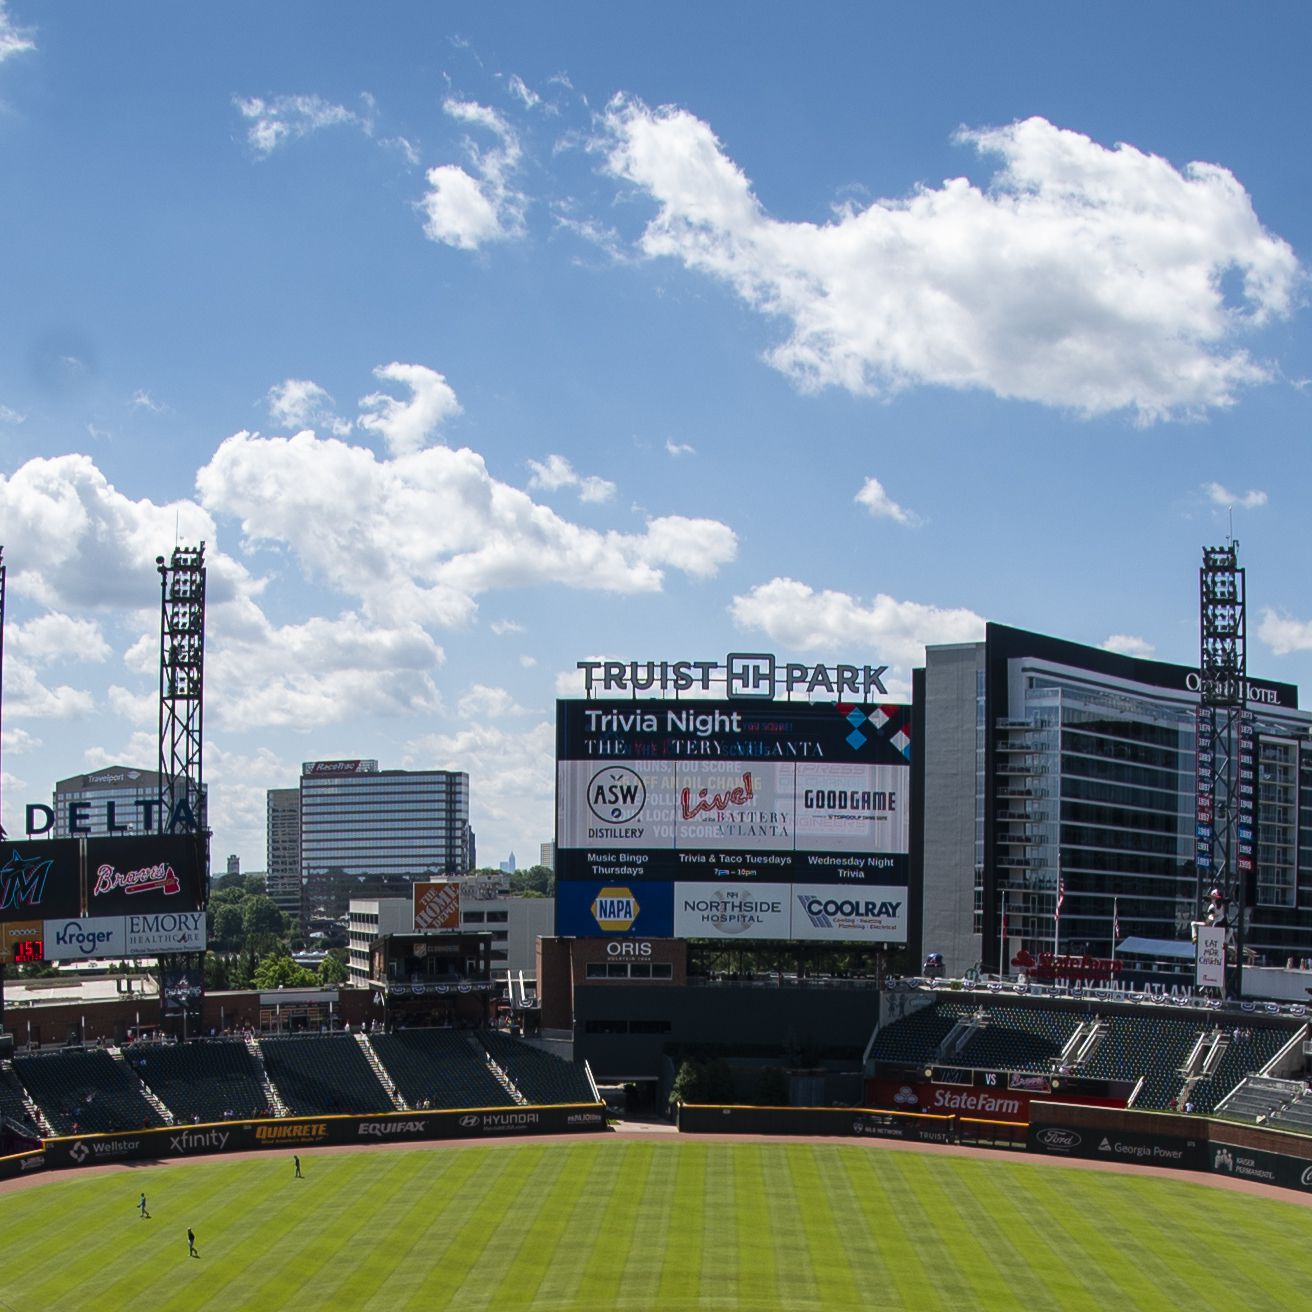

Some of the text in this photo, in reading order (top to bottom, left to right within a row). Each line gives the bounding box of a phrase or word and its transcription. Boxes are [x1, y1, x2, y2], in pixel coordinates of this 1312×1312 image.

[577, 661, 888, 695] TRUIST PARK
[1238, 680, 1281, 704] HOTEL
[585, 710, 657, 732] Trivia
[667, 710, 742, 736] Night
[585, 739, 626, 755] THE
[88, 773, 125, 784] Travelport
[593, 785, 639, 805] ASW
[681, 772, 754, 820] Live!
[26, 799, 199, 835] DELTA
[717, 811, 789, 823] BATTERY
[588, 828, 644, 839] DISTILLERY
[719, 825, 789, 837] ATLANTA
[588, 853, 649, 865] Music Bingo
[680, 854, 792, 866] Trivia & Taco Tuesdays
[808, 856, 894, 869] Wednesday Night
[592, 865, 644, 876] Thursdays
[838, 869, 865, 879] Trivia
[94, 862, 168, 896] Braves
[420, 887, 438, 906] THE
[416, 883, 459, 929] HOME
[432, 899, 460, 928] DEPOT
[599, 899, 633, 919] NAPA
[684, 901, 782, 913] NORTHSIDE
[807, 900, 902, 918] COOLRAY
[130, 913, 202, 934] EMORY
[702, 915, 763, 923] HOSPITAL
[56, 922, 113, 954] Kroger
[130, 933, 200, 945] HEALTHCARE
[1204, 939, 1218, 948] EAT
[18, 940, 43, 955] 157
[606, 942, 652, 956] ORIS
[1203, 948, 1219, 956] MOR
[985, 1073, 997, 1086] VS
[483, 1113, 539, 1125] HYUNDAI
[255, 1123, 328, 1140] QUIKRETE
[357, 1120, 425, 1137] EQUIFAX
[877, 1128, 904, 1137] NETWORK
[920, 1131, 947, 1141] TRUIST
[169, 1129, 230, 1153] xfinity
[1043, 1130, 1075, 1146] Ford
[93, 1140, 140, 1153] Wellstar
[1114, 1142, 1184, 1160] Georgia Power
